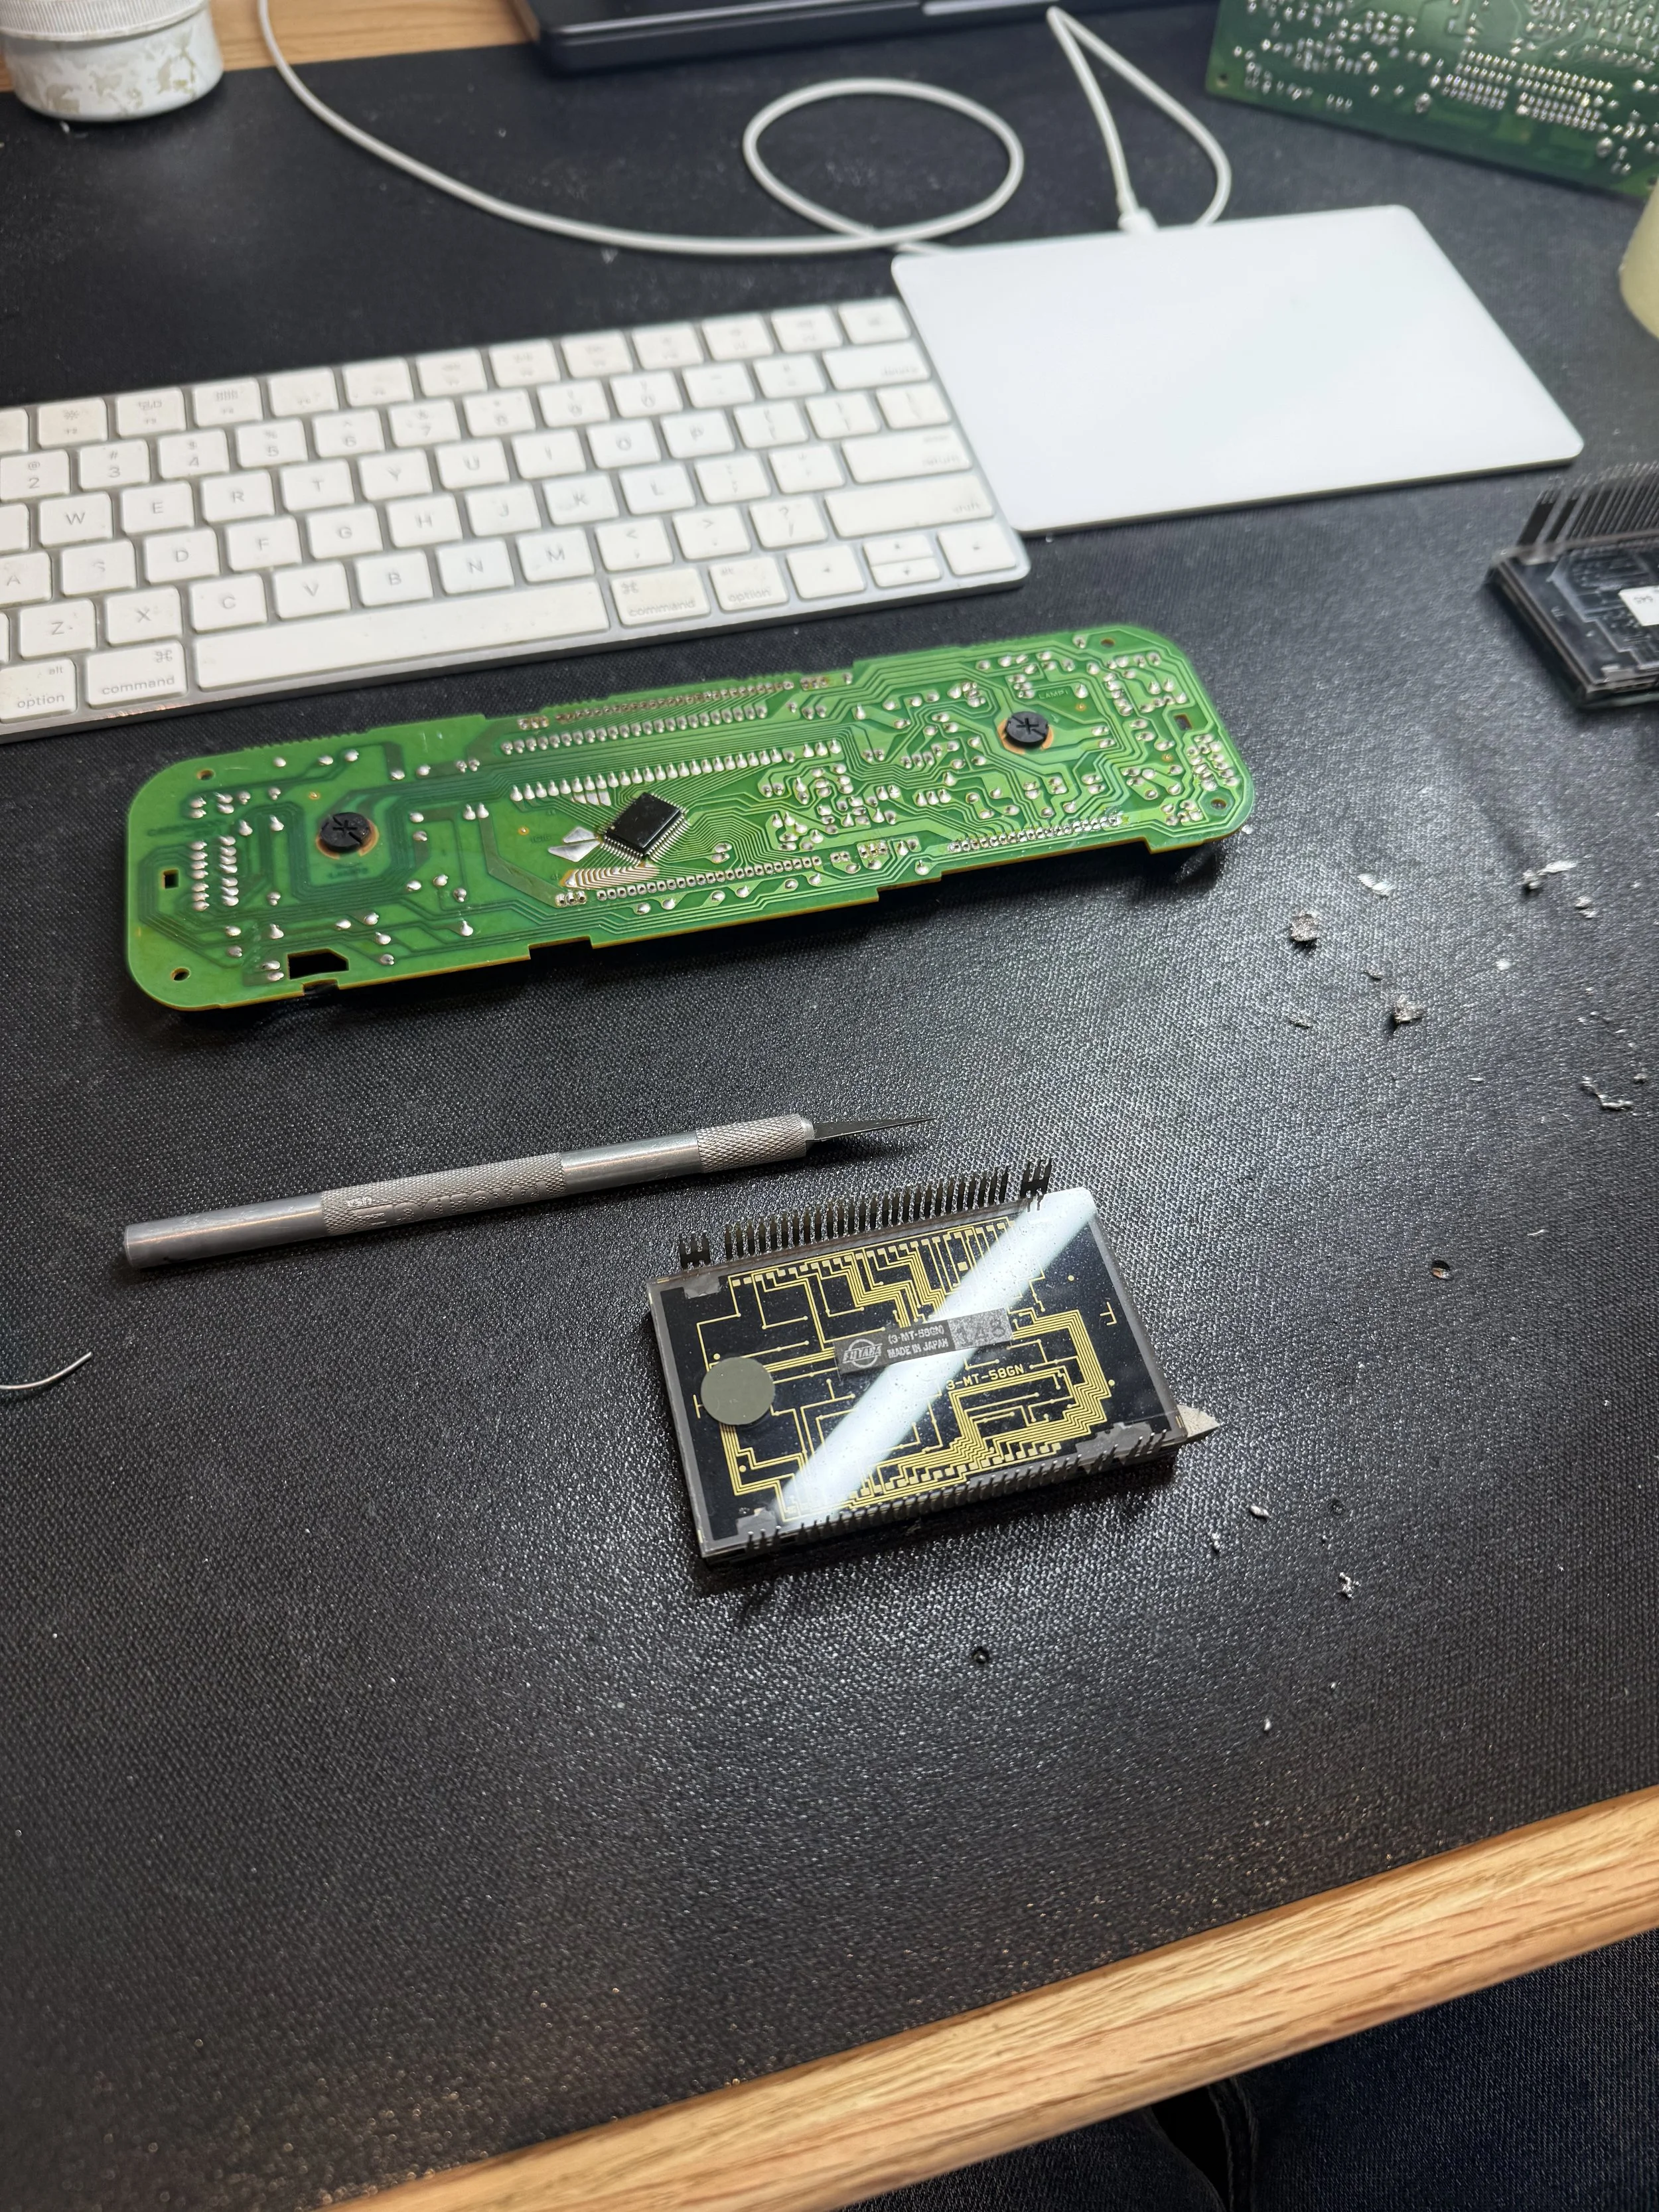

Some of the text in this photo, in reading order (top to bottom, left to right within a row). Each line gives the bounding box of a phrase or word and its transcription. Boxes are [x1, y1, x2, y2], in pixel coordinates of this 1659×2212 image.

[614, 435, 632, 451] O
[109, 451, 118, 460] #
[266, 445, 279, 457] 5
[28, 461, 40, 471] @
[188, 456, 199, 468] 4
[465, 457, 480, 471] U
[108, 466, 121, 479] 3
[388, 467, 402, 481] Y
[28, 477, 40, 489] 2
[312, 479, 325, 492] T
[650, 481, 665, 496] L
[231, 490, 244, 503] R
[152, 502, 164, 514] E
[498, 502, 510, 518] J
[66, 512, 86, 525] W
[415, 512, 433, 528] H
[336, 526, 353, 540] G
[257, 538, 270, 550] F
[175, 550, 189, 563] D
[545, 548, 565, 563] M
[467, 558, 483, 573] N
[6, 573, 21, 587] A
[387, 571, 401, 585] B
[303, 583, 319, 597] V
[222, 595, 236, 609] C
[626, 597, 697, 619] command
[136, 608, 151, 623] X
[50, 621, 64, 636] Z
[48, 666, 64, 676] alt
[101, 676, 176, 696] command
[17, 692, 66, 710] option
[347, 1194, 373, 1209] USA
[842, 1343, 883, 1364] FUTABA
[886, 1337, 949, 1359] MADE IN JAPAN
[945, 1363, 1025, 1391] 3-MT-58GN
